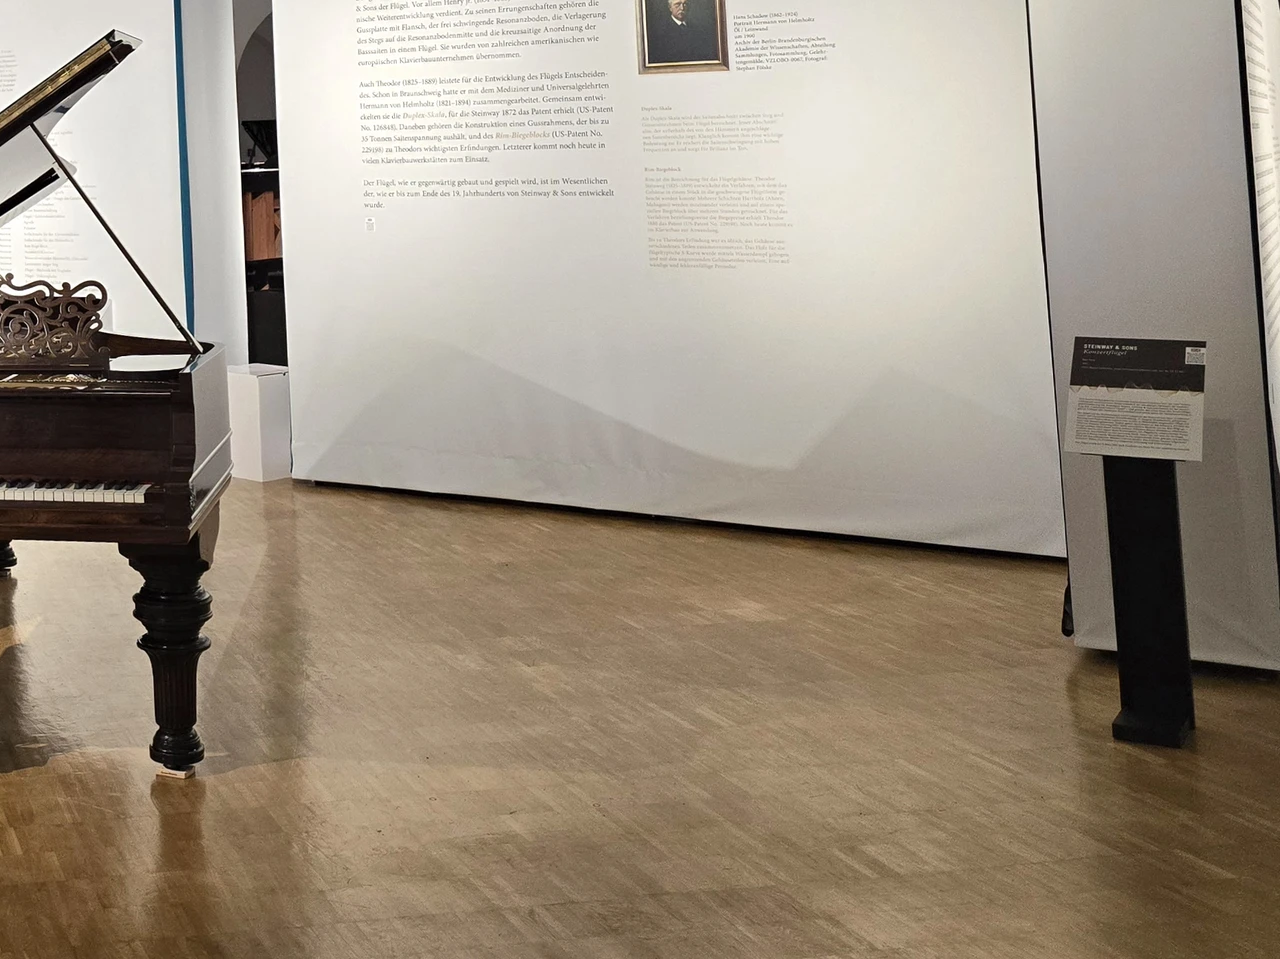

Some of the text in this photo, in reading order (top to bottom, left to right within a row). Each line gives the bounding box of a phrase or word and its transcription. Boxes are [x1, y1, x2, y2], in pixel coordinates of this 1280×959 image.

[356, 5, 361, 13] &
[363, 4, 377, 12] Sons
[379, 3, 388, 11] der
[413, 0, 423, 8] Vor
[357, 14, 375, 23] nische
[465, 7, 474, 16] Zu
[476, 6, 496, 15] seinen
[559, 0, 587, 11] gehören
[357, 24, 388, 36] Gussplatte
[429, 21, 439, 29] der
[441, 20, 452, 28] frei
[453, 18, 494, 30] schwingende
[552, 13, 565, 21] die
[566, 10, 607, 22] Verlagerung
[360, 101, 389, 110] Hermann
[403, 99, 434, 108] Helmholtz
[542, 94, 583, 103] Gemeinsam
[360, 112, 381, 121] ckelten
[460, 109, 470, 117] die
[472, 108, 500, 119] Steinway
[502, 108, 517, 116] 1872
[518, 108, 530, 116] das
[532, 107, 552, 115] Patent
[553, 106, 575, 114] erhielt
[576, 105, 614, 116] (US-Patent
[400, 122, 426, 130] Daneben
[454, 121, 463, 129] die
[465, 120, 508, 129] Konstruktion
[576, 117, 588, 125] der
[457, 178, 479, 188] gebaut
[495, 178, 519, 188] gespielt
[563, 177, 608, 185] Wesentlichen
[521, 189, 550, 199] Steinway
